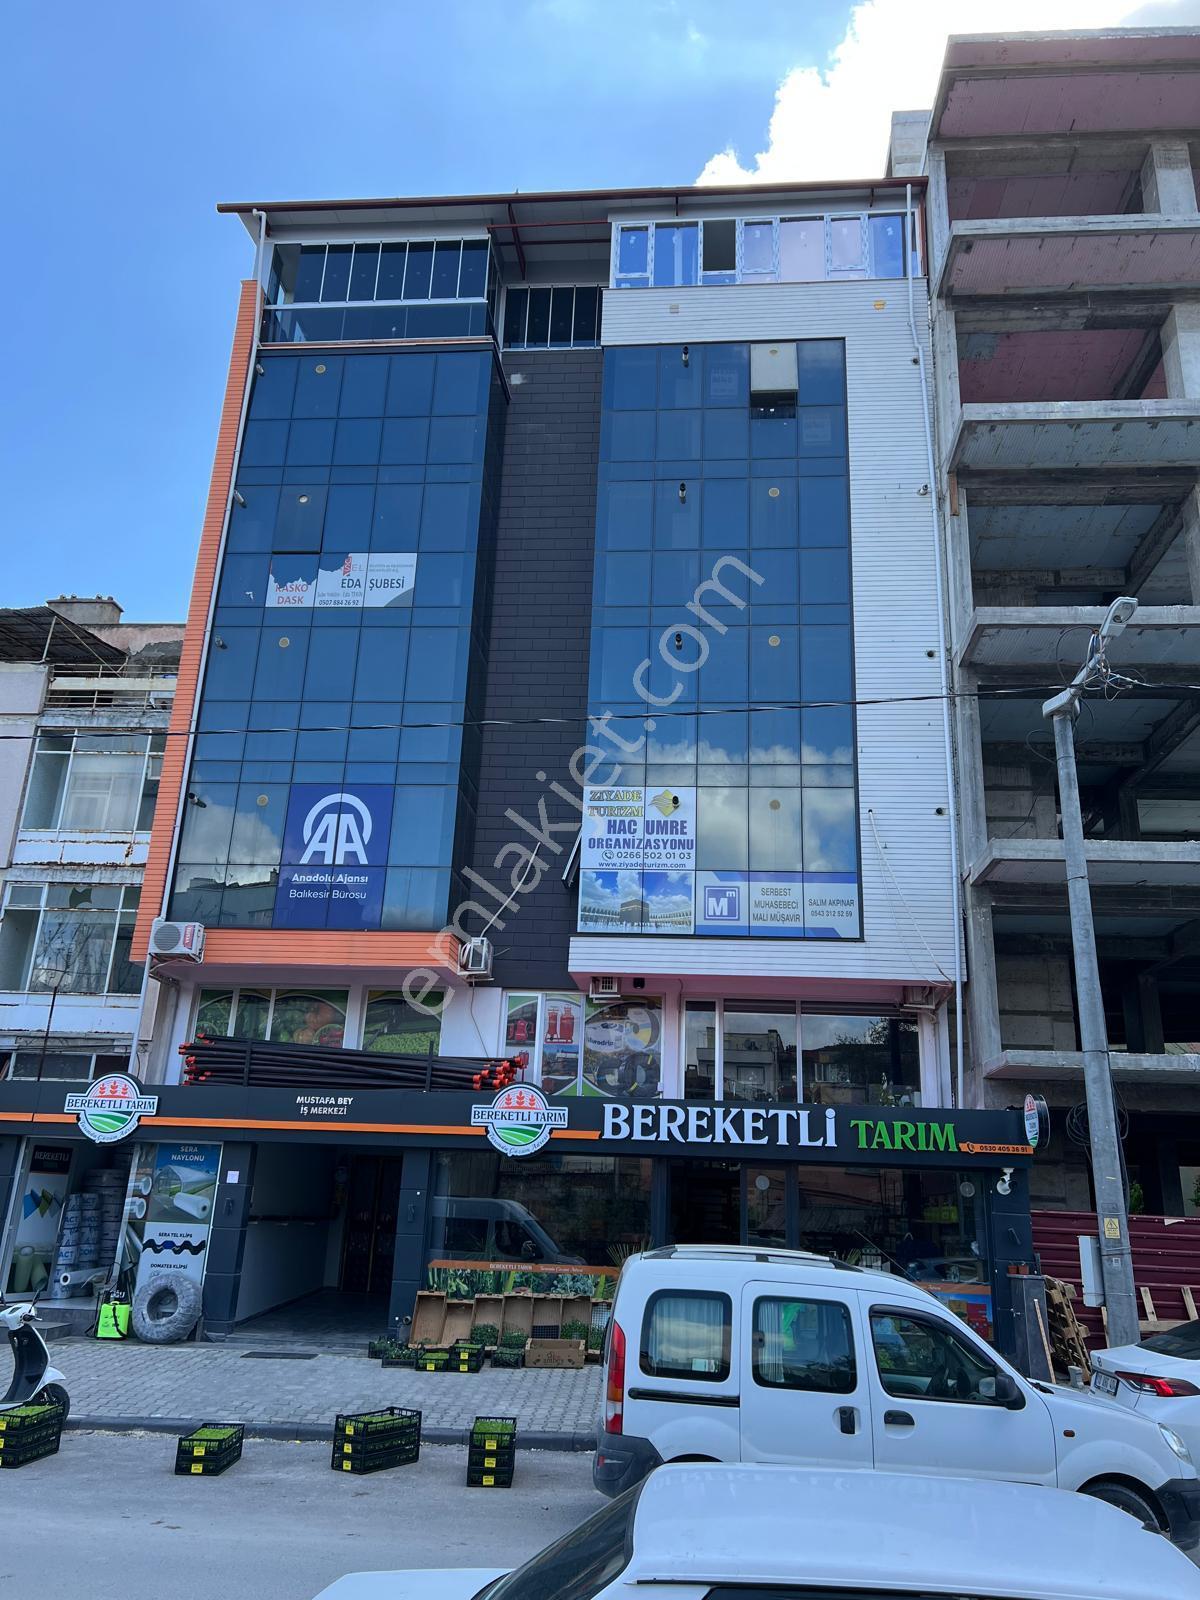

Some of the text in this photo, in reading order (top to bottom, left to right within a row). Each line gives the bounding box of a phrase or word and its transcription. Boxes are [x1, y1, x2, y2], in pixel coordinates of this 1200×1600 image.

[341, 576, 404, 591] EDA ŞUBESİ
[277, 596, 304, 605] DASK
[607, 819, 687, 835] HAC UMRE
[588, 836, 694, 850] ORGANİZASYONU
[616, 851, 691, 860] 0266 502 01 03
[598, 861, 686, 869] www.ziyadeturizm.com
[291, 873, 368, 883] Anadolu Ajansı
[289, 889, 367, 899] Balıkesir Bürosu
[761, 887, 791, 896] SERBEST
[67, 1099, 155, 1110] BEREKETLİ TARIM
[296, 1096, 353, 1105] MUSTAFA BEY
[300, 1104, 347, 1115] İŞ MERKEZİ
[473, 1110, 566, 1123] BEREKETLİ TARIM
[601, 1103, 959, 1153] BEREKETLİ TARIM
